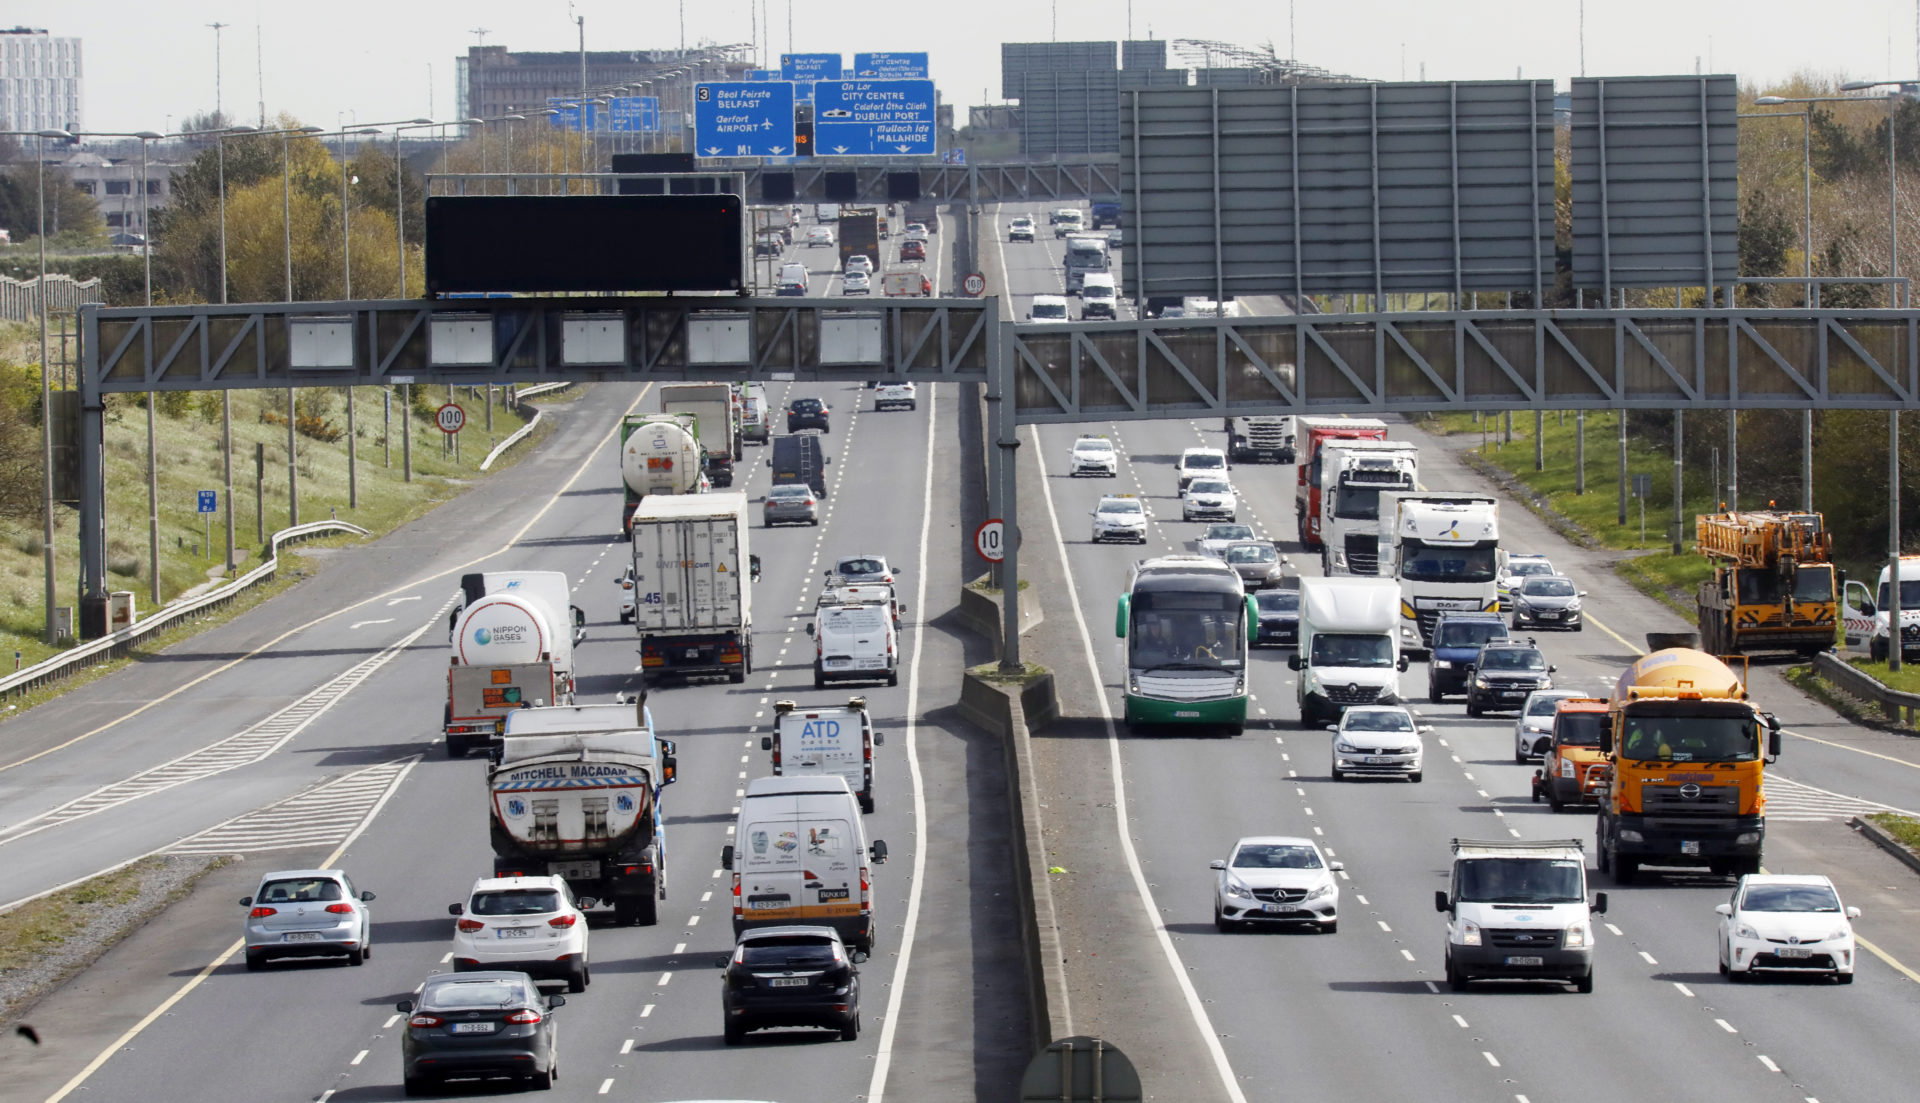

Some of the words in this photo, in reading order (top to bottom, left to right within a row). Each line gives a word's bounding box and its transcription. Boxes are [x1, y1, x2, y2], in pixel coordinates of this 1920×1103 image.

[700, 89, 708, 100] 3
[842, 92, 863, 100] CITY
[866, 92, 905, 100] CENTRE
[718, 100, 760, 109] BELFAST
[855, 112, 891, 120] DUBLIN
[895, 112, 920, 120] PORT
[717, 124, 758, 132] AIRPORT
[877, 134, 928, 142] MALAHIDE
[441, 410, 461, 424] 100
[645, 592, 661, 604] 45
[493, 625, 527, 633] NIPPON
[493, 633, 521, 641] GASES
[801, 720, 840, 739] ATD
[511, 766, 567, 781] MITCHELL
[571, 765, 628, 778] MACADAM
